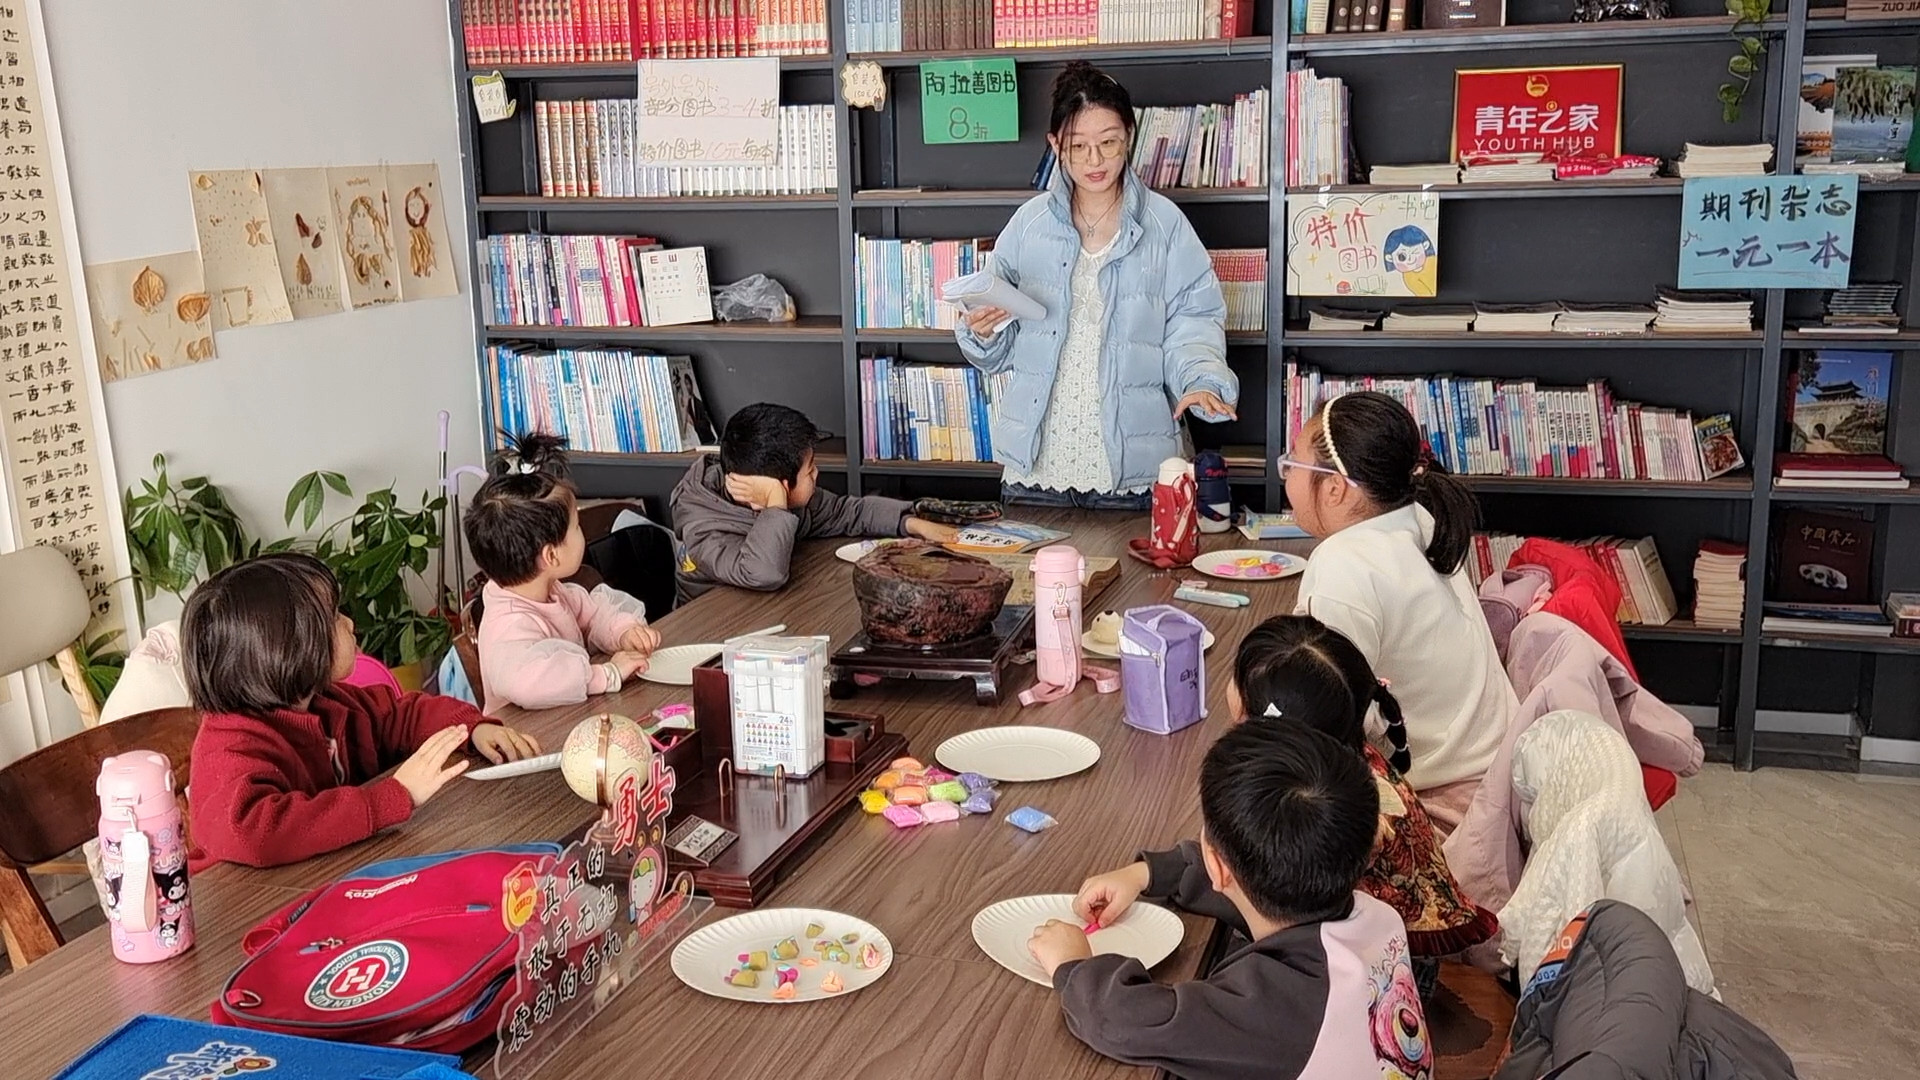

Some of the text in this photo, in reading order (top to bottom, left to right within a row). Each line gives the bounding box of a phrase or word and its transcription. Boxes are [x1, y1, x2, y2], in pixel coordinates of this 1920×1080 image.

[924, 70, 1017, 96] 阿拉善图书
[949, 107, 989, 140] 8折
[1474, 104, 1600, 136] 青年之家
[1474, 136, 1596, 151] YOUTH HUB
[1699, 183, 1852, 222] 期刊杂志
[1305, 207, 1375, 251] 特价
[1338, 245, 1379, 273] 图书
[1695, 231, 1850, 269] 一元一本
[612, 756, 676, 854] 勇士
[540, 842, 605, 925] 真正的
[331, 981, 394, 1008] HONGEN
[335, 963, 381, 993] H
[508, 929, 622, 1054] 震动的手机
